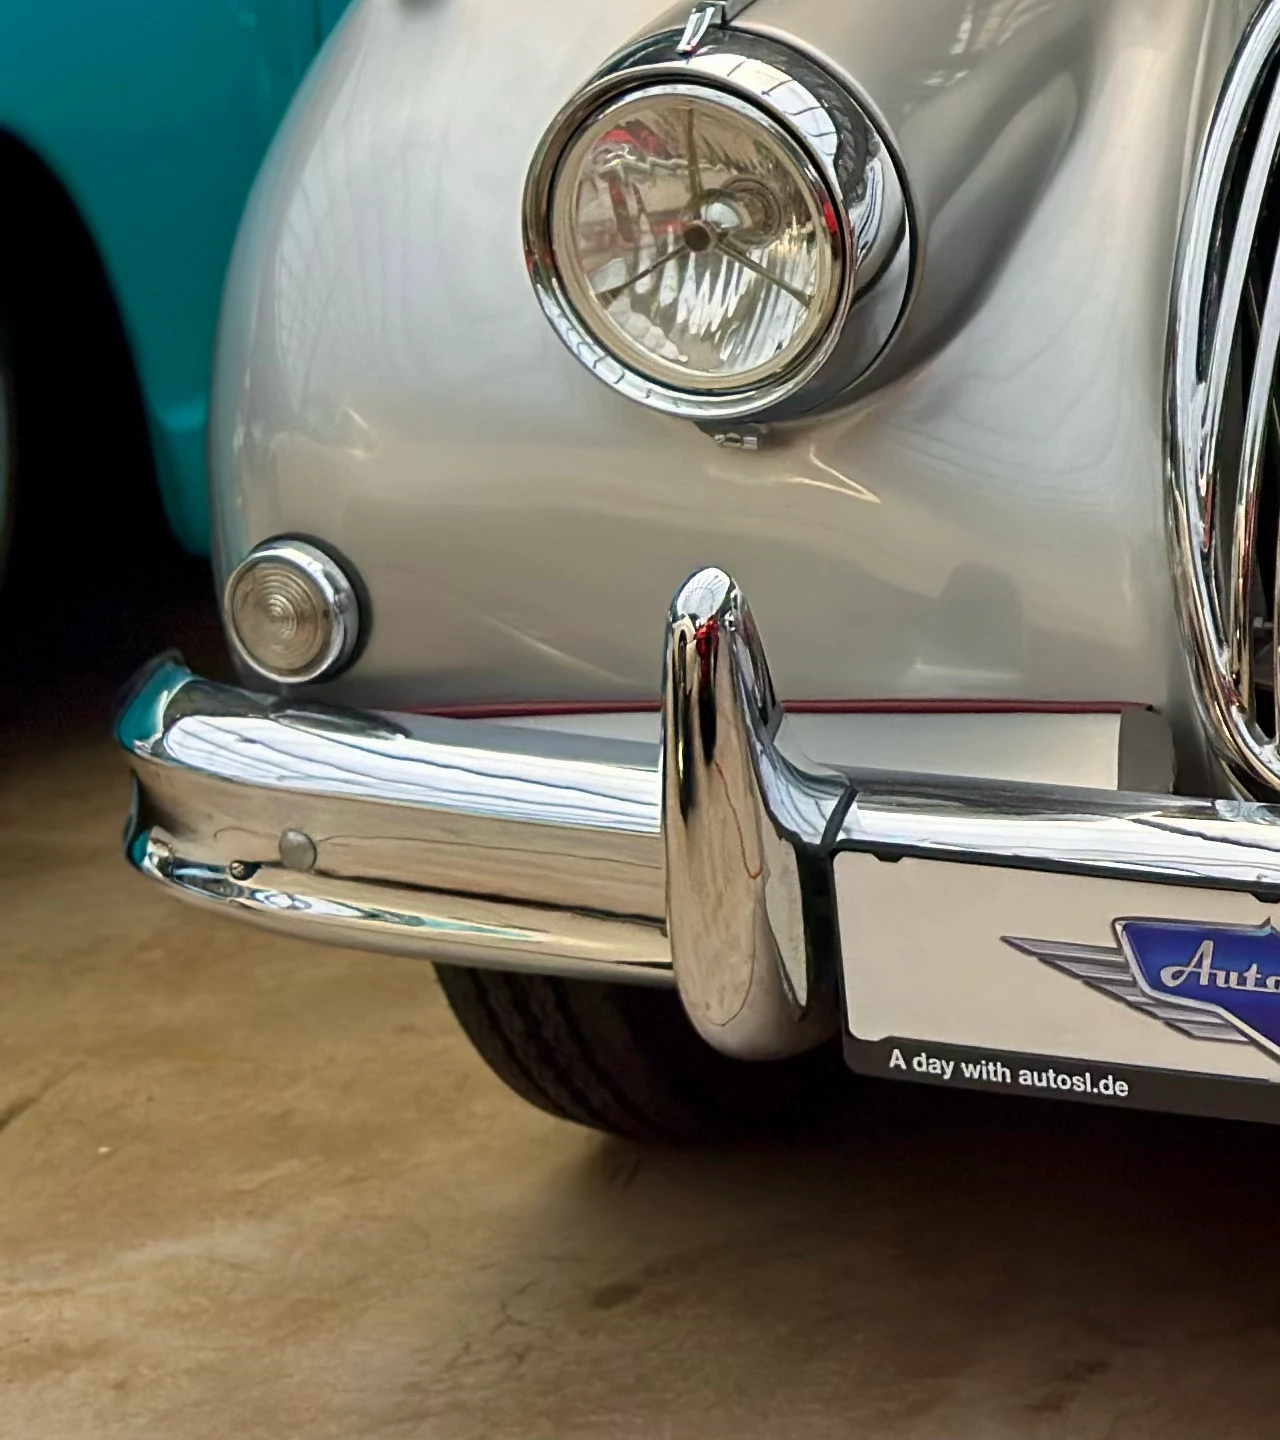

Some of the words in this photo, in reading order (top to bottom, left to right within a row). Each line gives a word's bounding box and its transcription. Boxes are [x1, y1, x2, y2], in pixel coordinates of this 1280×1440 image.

[888, 1048, 907, 1070] A
[912, 1052, 954, 1080] day
[960, 1059, 1011, 1084] with
[1018, 1068, 1129, 1098] autosl.de
